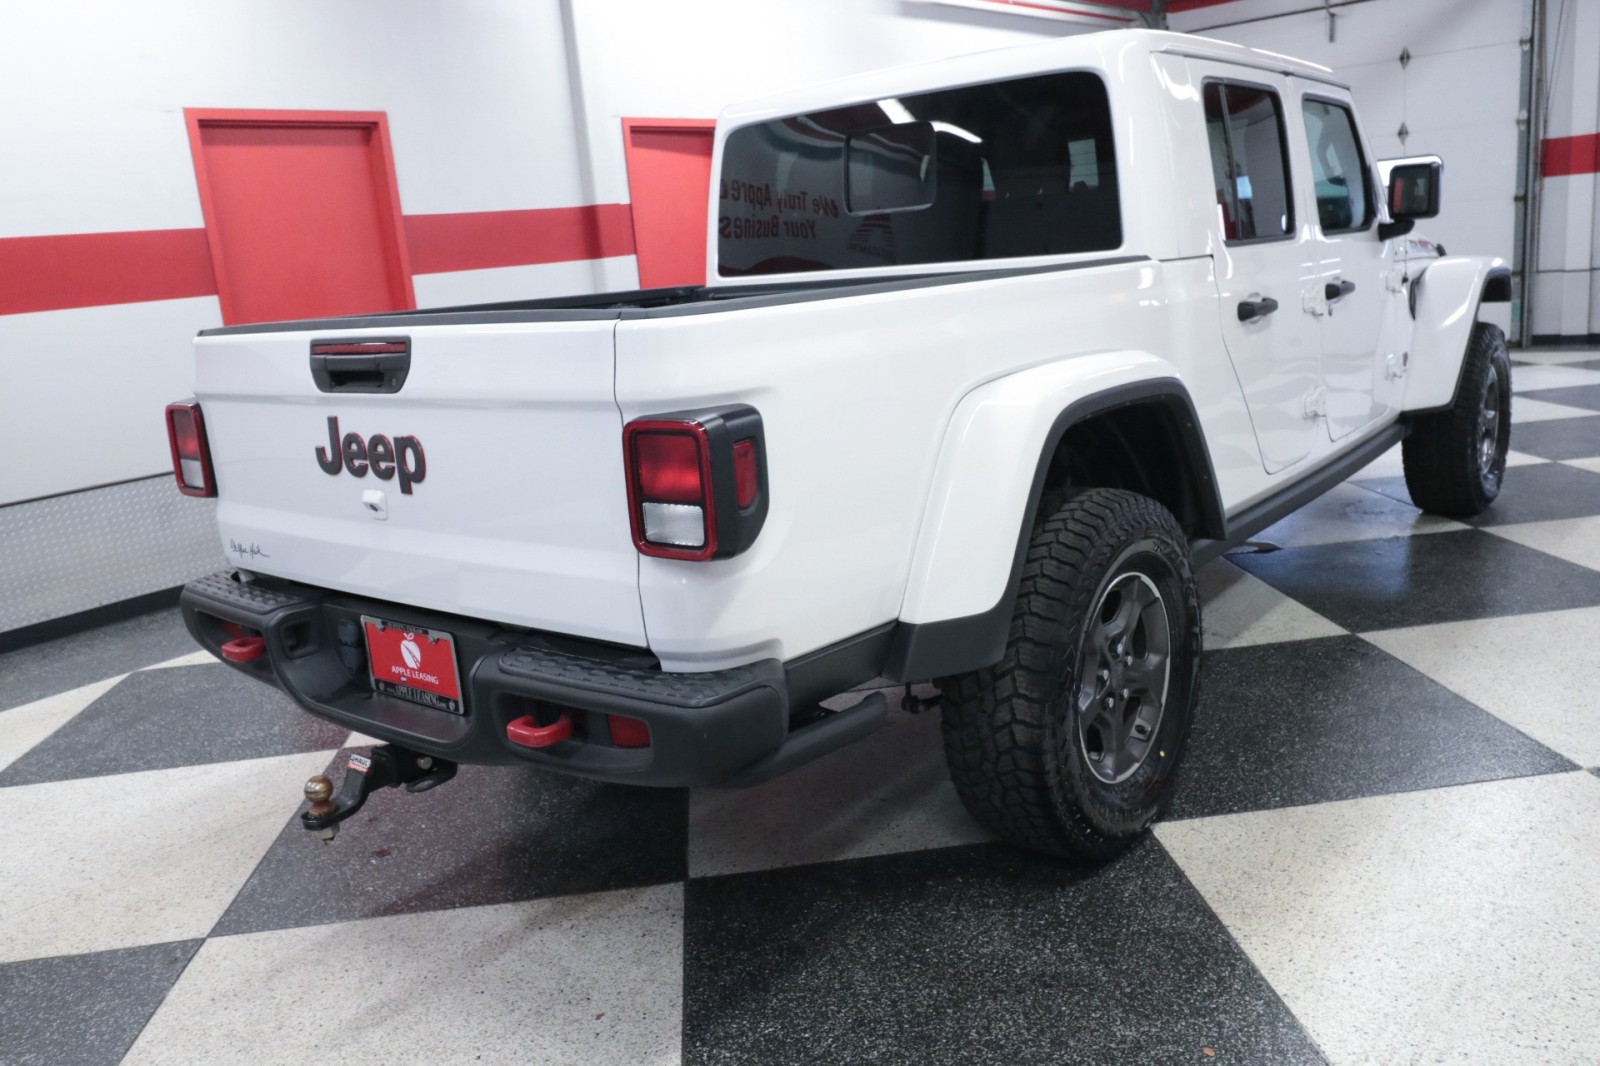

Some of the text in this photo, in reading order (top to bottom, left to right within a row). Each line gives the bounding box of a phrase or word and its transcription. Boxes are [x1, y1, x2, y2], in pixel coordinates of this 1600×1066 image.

[315, 416, 427, 495] Jeep
[391, 665, 411, 677] APPLE
[412, 670, 439, 685] LEASING
